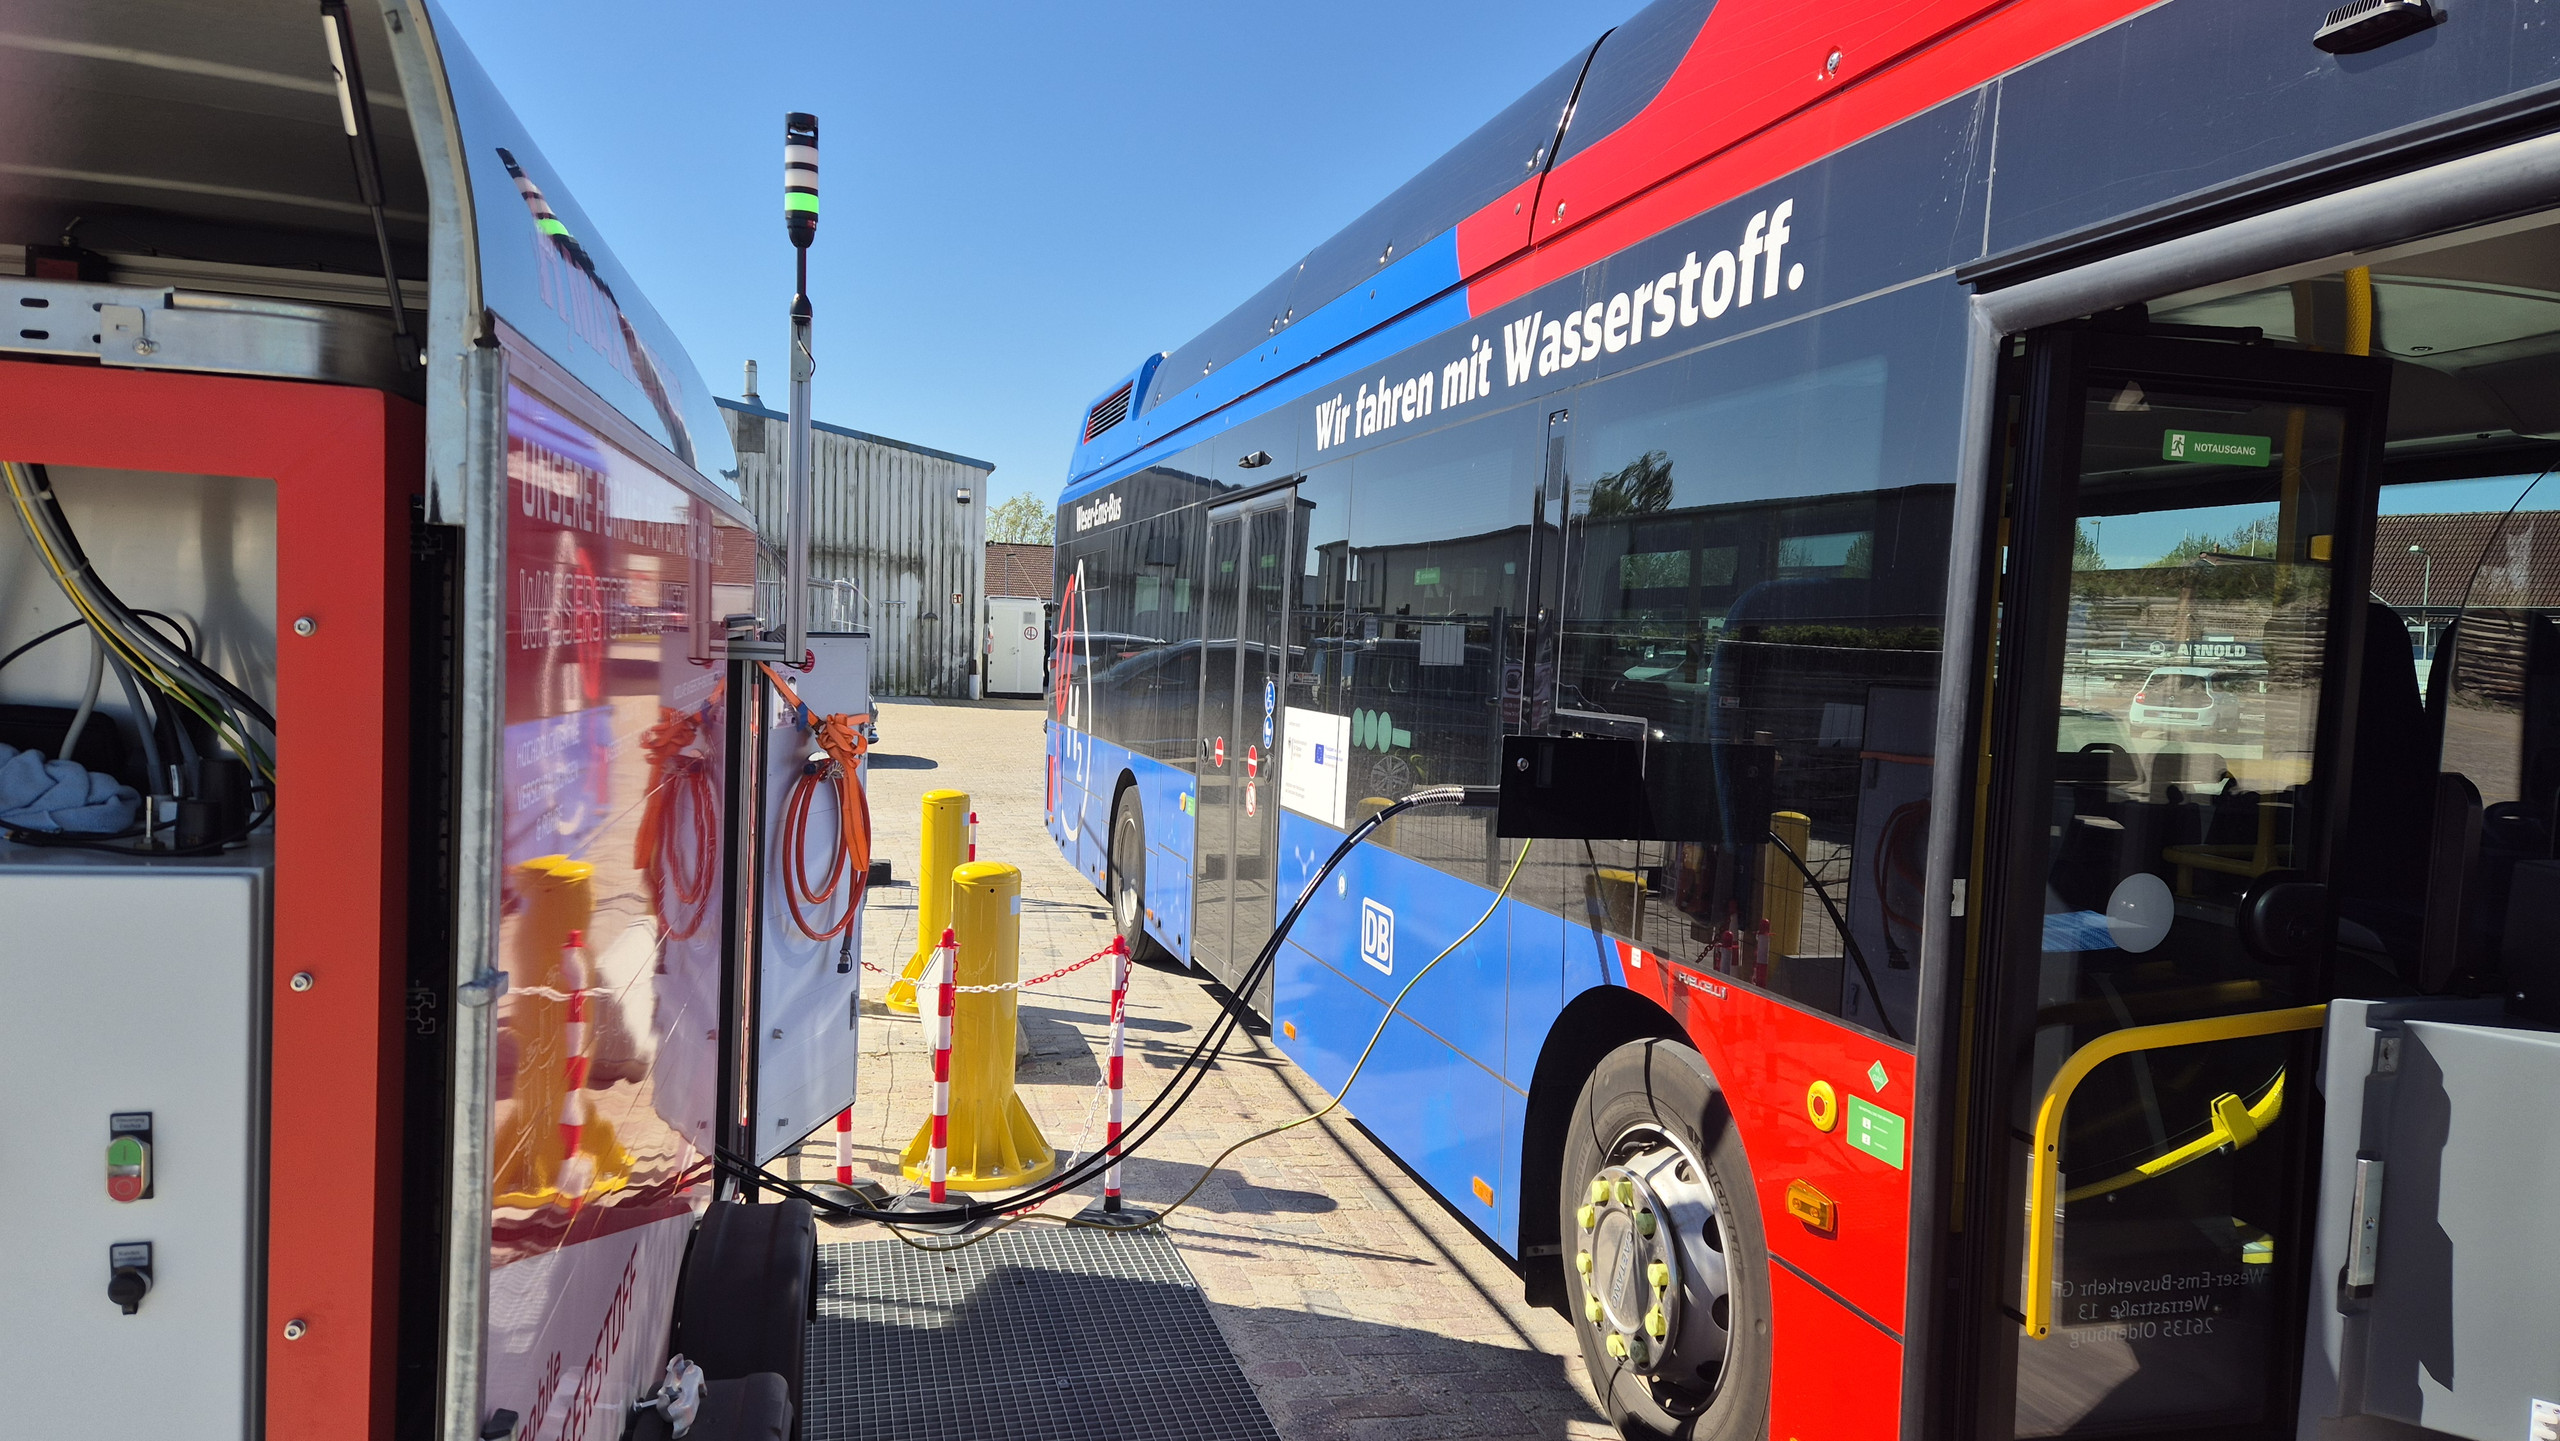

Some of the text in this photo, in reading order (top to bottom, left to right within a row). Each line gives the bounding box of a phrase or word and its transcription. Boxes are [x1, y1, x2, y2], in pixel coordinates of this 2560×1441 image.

[1316, 198, 1805, 451] Wir fahren mit Wasserstoff.
[2194, 443, 2256, 456] NOTAUSGANG
[522, 437, 592, 532] UNSERE
[1076, 493, 1122, 533] Weser-Ems-Bus
[2177, 643, 2247, 657] ARNOLD
[1364, 907, 1391, 963] DB
[1611, 1231, 1633, 1309] CAETANO
